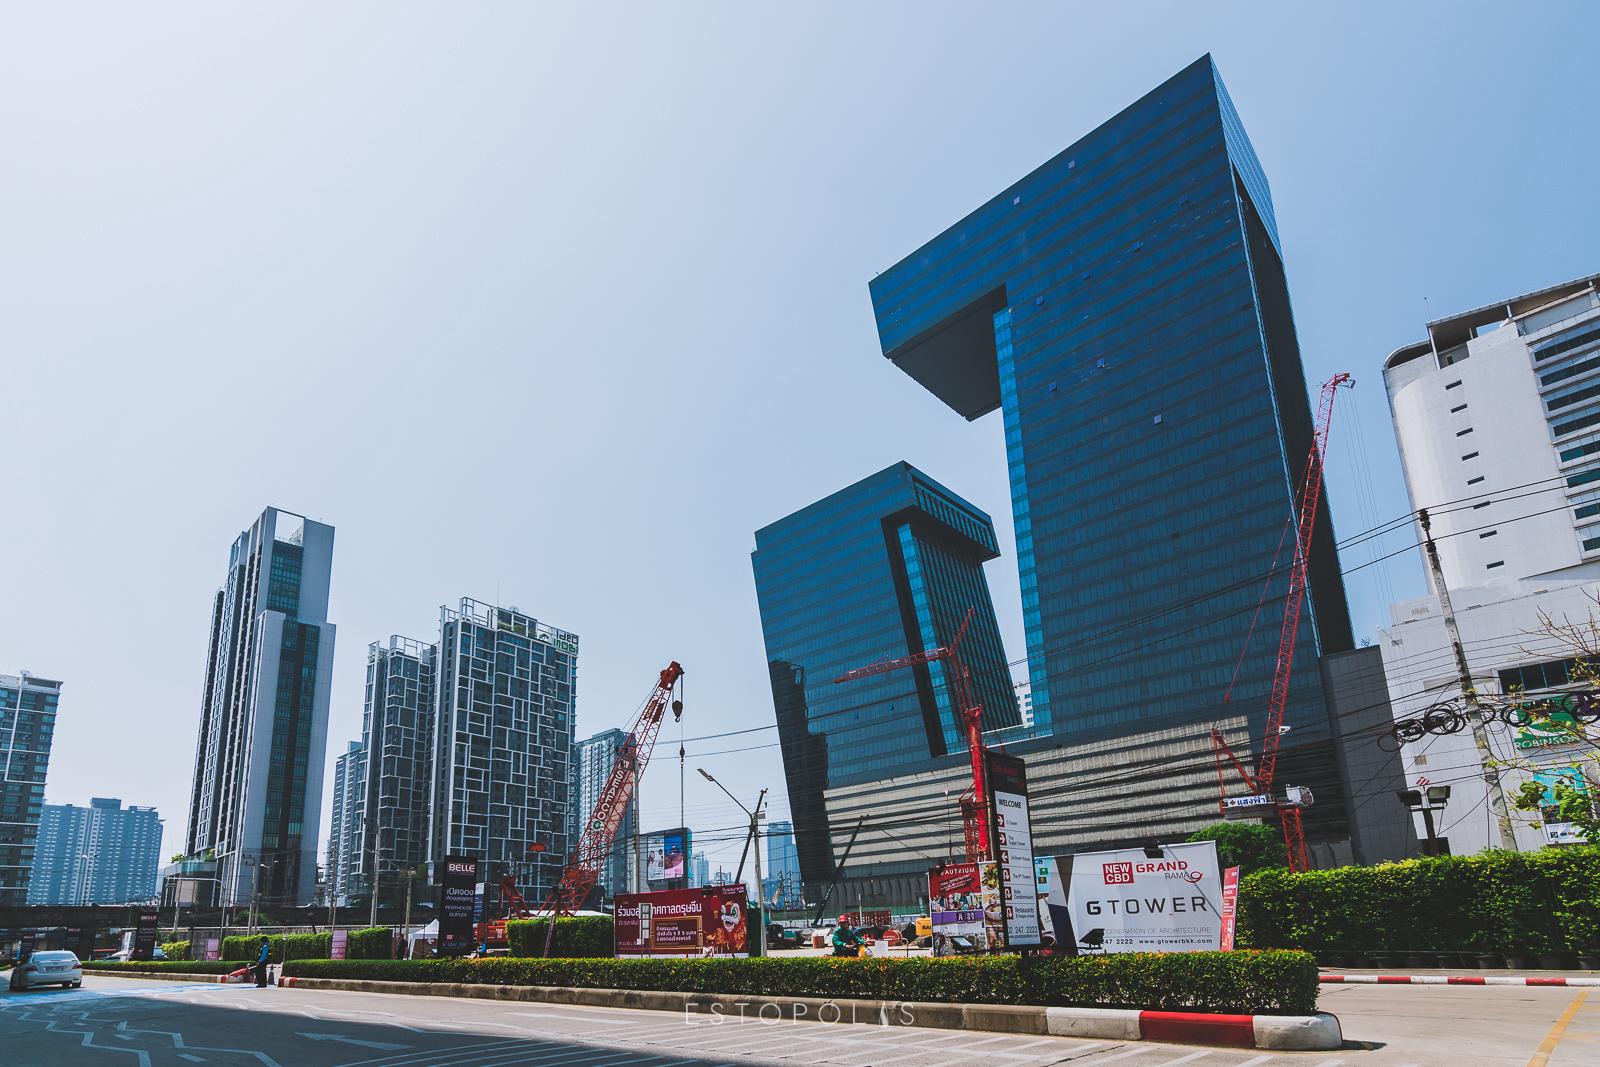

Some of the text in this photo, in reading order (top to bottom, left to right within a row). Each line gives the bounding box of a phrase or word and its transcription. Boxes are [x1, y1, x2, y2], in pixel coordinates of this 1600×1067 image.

[1513, 735, 1580, 749] ROBINSON
[597, 770, 624, 821] SEAFCO
[998, 799, 1022, 808] WELCOME
[448, 863, 476, 873] BELLE
[1105, 864, 1130, 874] NEW
[1136, 861, 1188, 873] GRAND
[1106, 873, 1131, 883] CBD
[1015, 926, 1024, 934] 247
[1025, 926, 1039, 934] 2222
